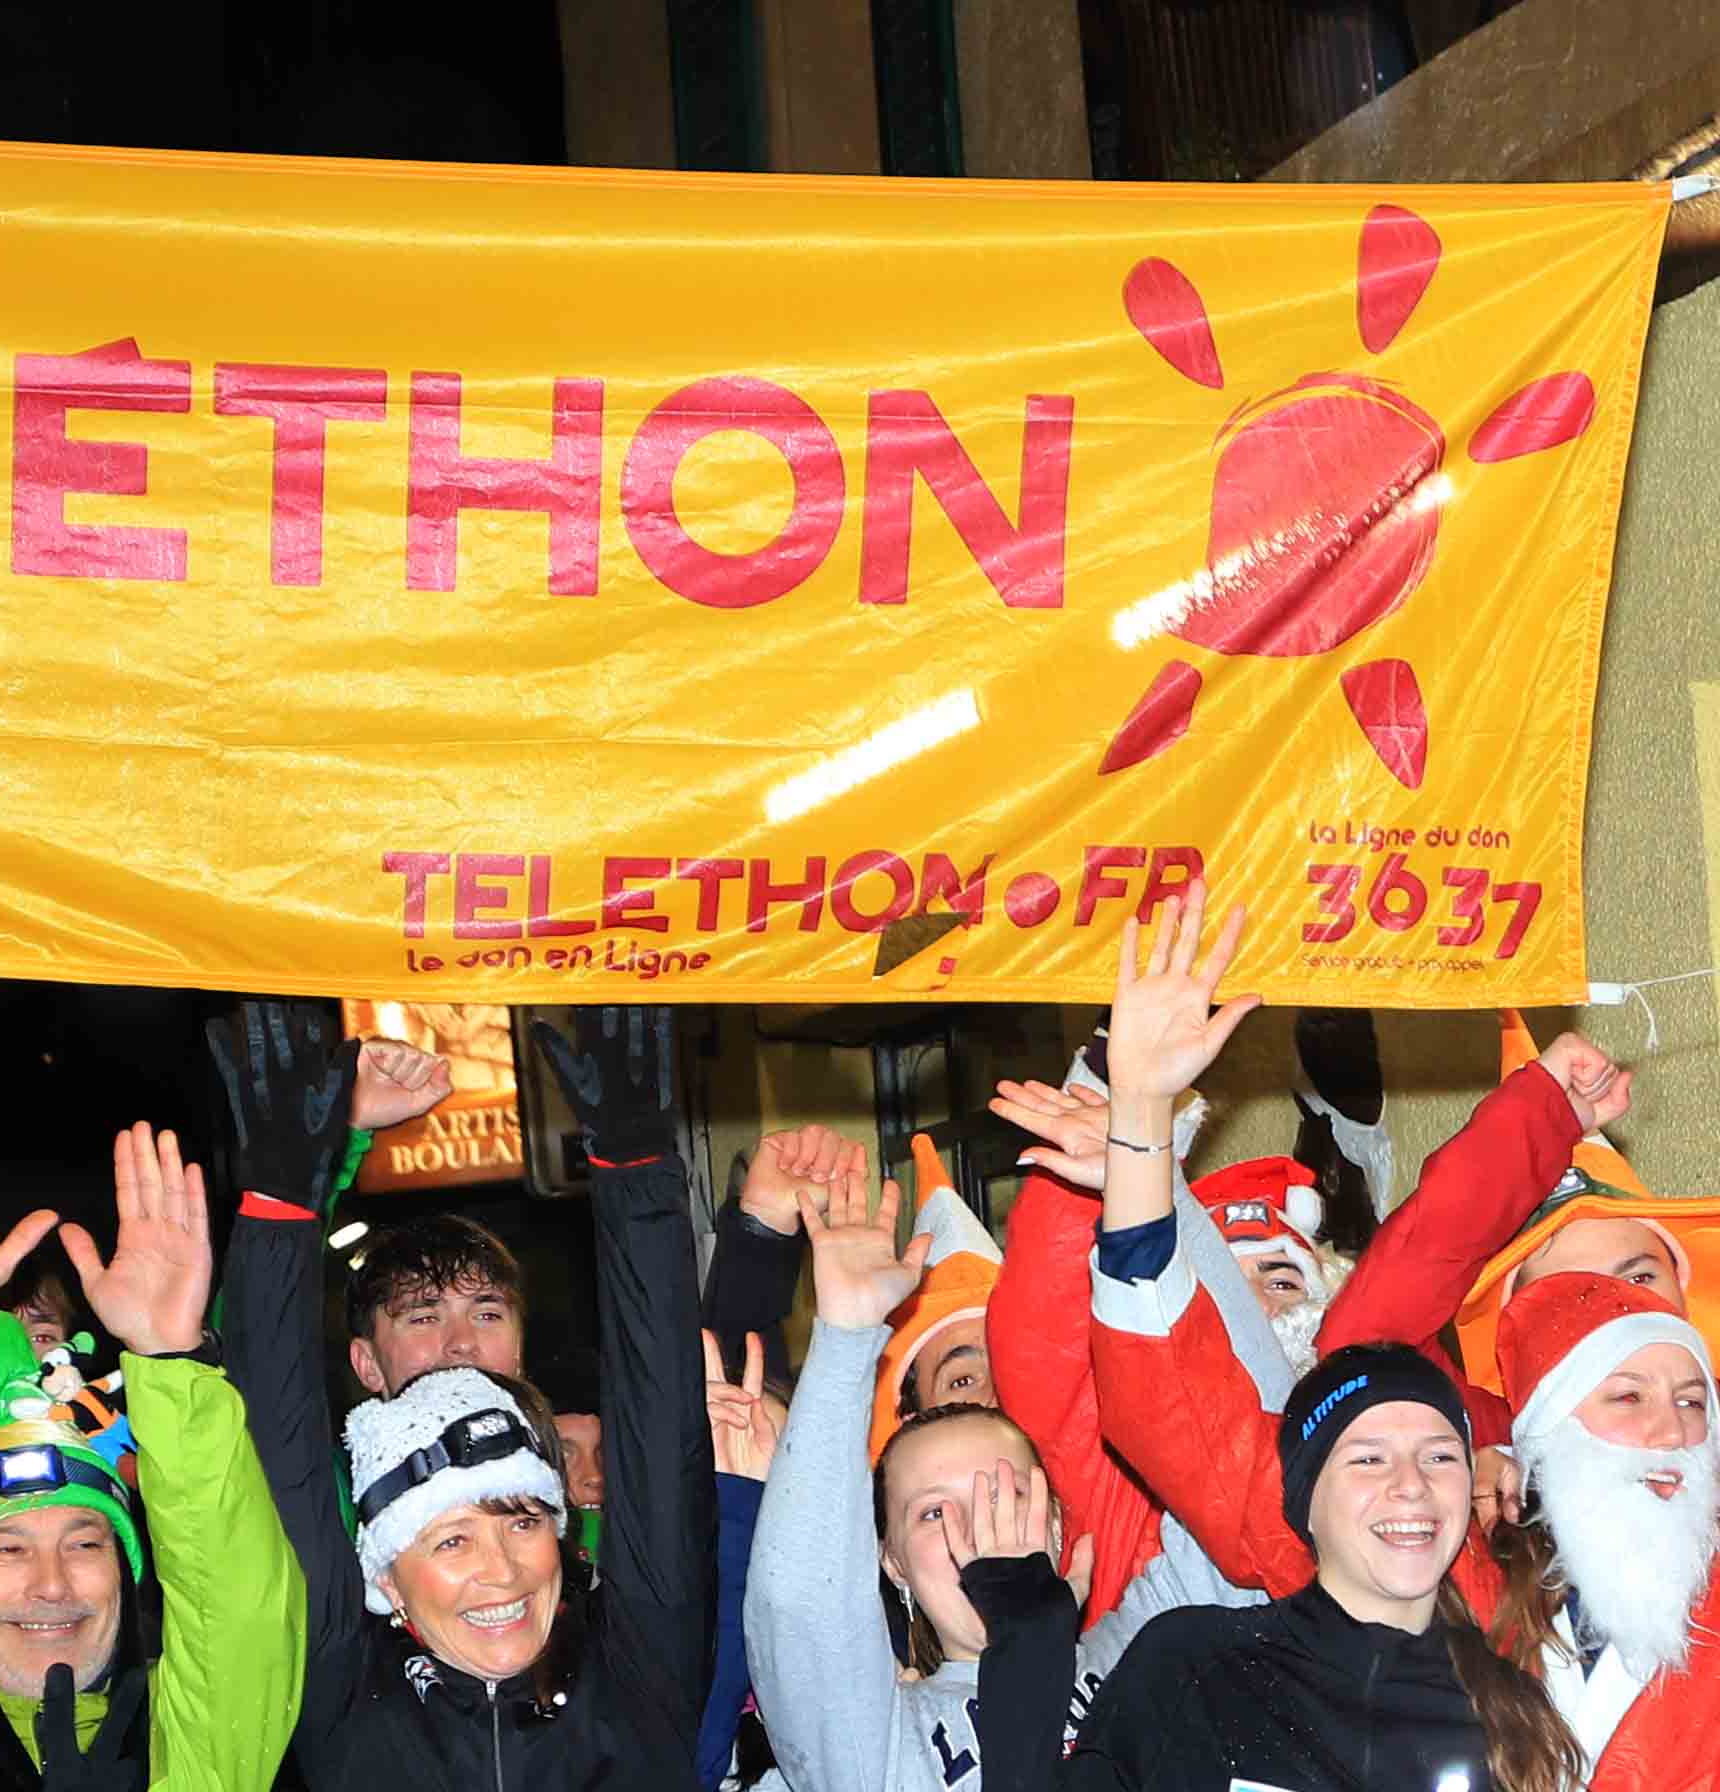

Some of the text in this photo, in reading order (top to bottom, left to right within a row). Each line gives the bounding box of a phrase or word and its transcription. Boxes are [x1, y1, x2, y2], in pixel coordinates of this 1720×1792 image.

[1425, 826, 1459, 847] du
[1467, 825, 1510, 849] don
[1302, 852, 1543, 960] 3637
[544, 944, 592, 969] en
[1302, 1375, 1369, 1441] ALTITUDE
